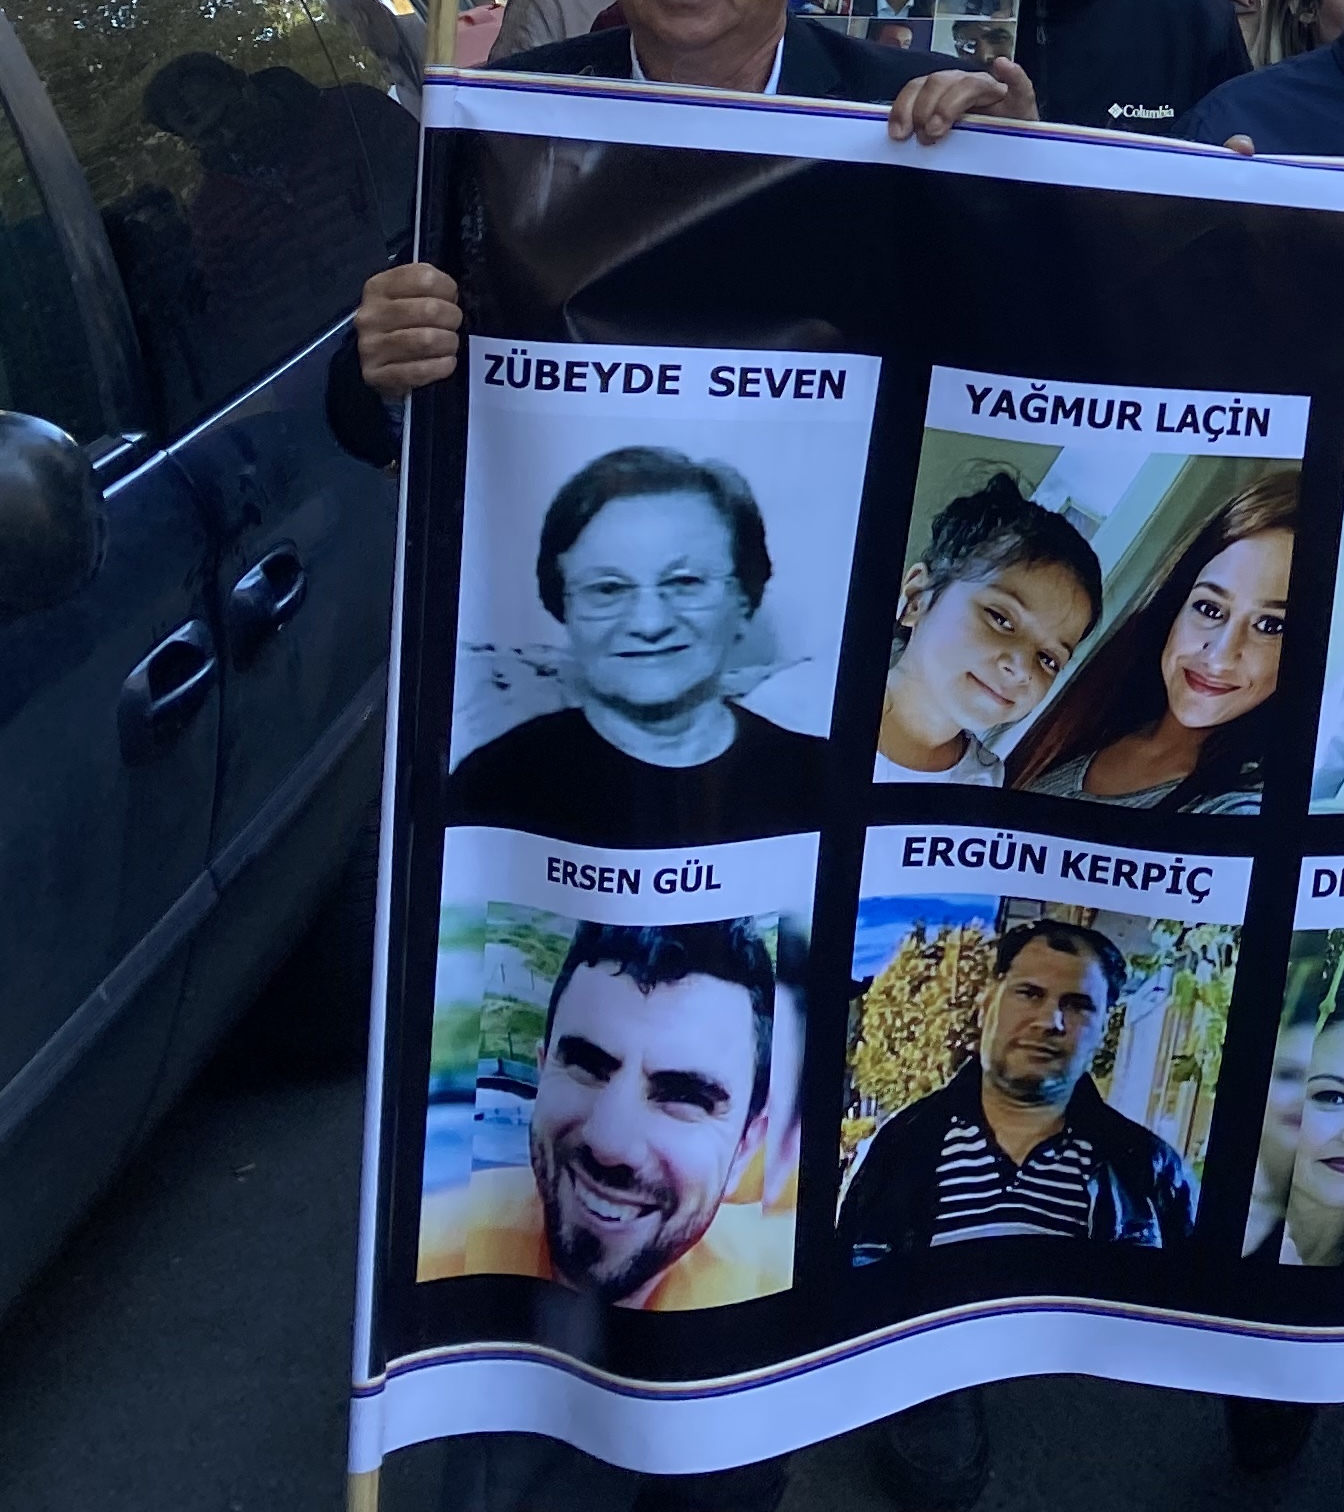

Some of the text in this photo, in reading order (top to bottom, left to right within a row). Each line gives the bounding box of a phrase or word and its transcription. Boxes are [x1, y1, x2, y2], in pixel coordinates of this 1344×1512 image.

[1123, 104, 1175, 119] Columbia
[484, 347, 849, 401] ZÜBEYDE SEVEN
[965, 383, 1272, 443] YAĞMUR LAÇİN
[545, 856, 723, 896] ERSEN GÜL
[901, 834, 1215, 904] ERGÜN KERPİÇ
